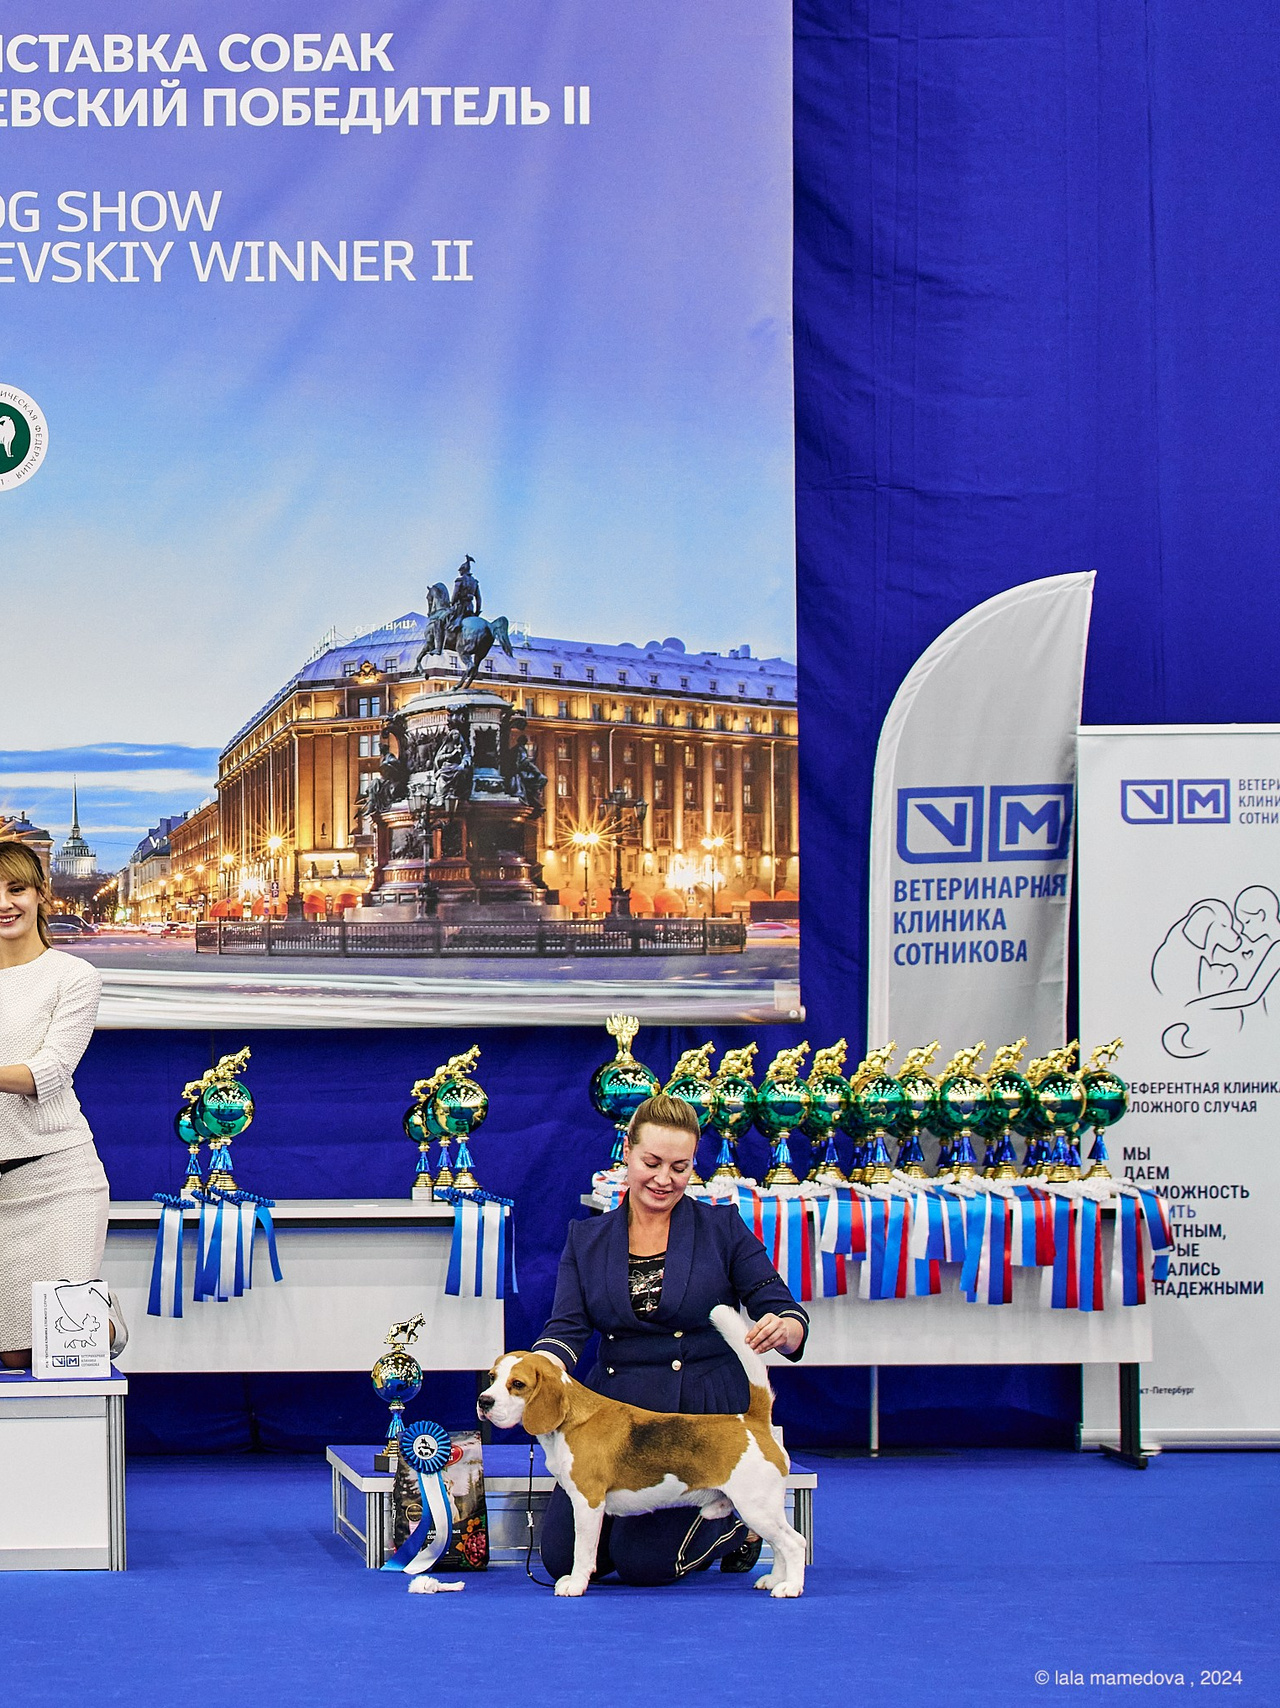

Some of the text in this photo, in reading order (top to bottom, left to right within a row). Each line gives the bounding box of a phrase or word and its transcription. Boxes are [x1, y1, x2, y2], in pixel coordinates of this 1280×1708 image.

[218, 32, 395, 73] СОБАК
[203, 86, 551, 135] ПОБЕДИТЕЛЬ
[563, 85, 590, 125] II
[57, 190, 223, 233] SHOW
[188, 240, 417, 282] WINNER
[431, 239, 474, 281] II
[15, 424, 44, 480] ФЕДЕРАЦИЯ
[893, 872, 1068, 903] ВЕТЕРИНАРНАЯ
[893, 908, 1007, 934] КЛИНИКА
[893, 939, 1028, 966] СОТНИКОВА
[1224, 1081, 1280, 1094] КЛИНИК
[1125, 1100, 1258, 1114] ЛОЖНОГО СЛУЧАЯ
[1123, 1146, 1151, 1161] МЫ
[1124, 1165, 1170, 1183] ДАЕМ
[1155, 1184, 1250, 1200] МОЖНОСТЬ
[1172, 1223, 1227, 1241] ТНЫМ,
[1166, 1261, 1221, 1277] АЛИСЬ
[1153, 1280, 1264, 1299] НАДЕЖНЫМИ
